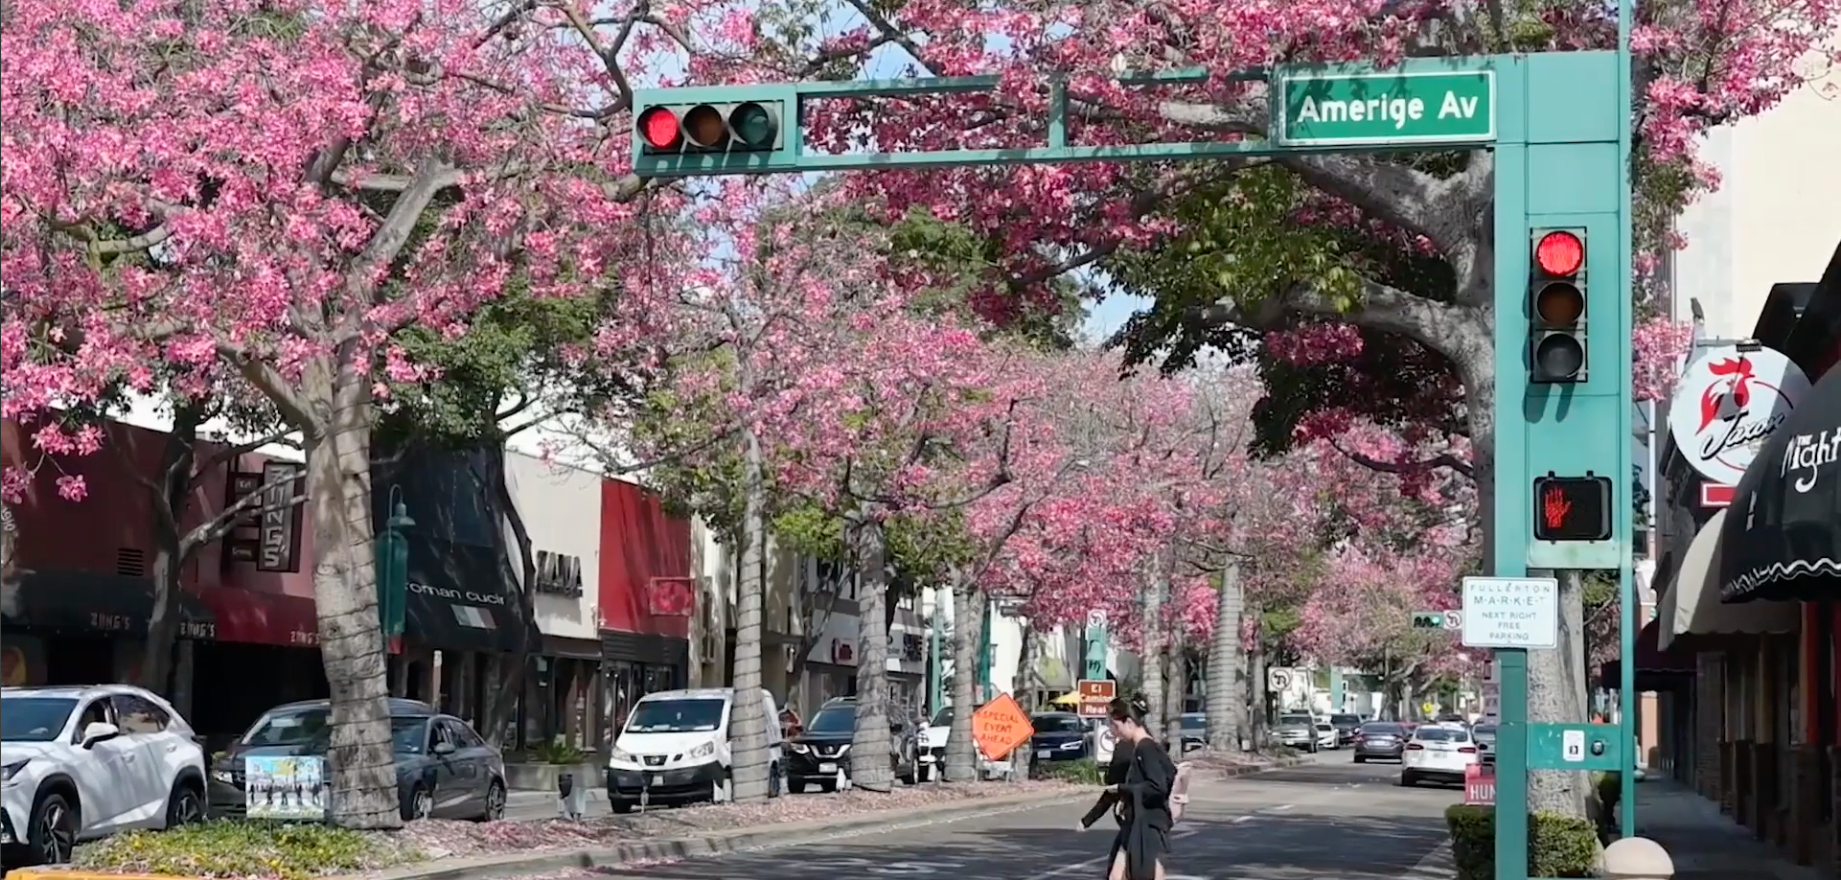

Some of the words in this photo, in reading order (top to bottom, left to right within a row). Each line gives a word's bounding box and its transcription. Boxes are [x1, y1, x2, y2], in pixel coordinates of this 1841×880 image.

[1297, 93, 1425, 130] Amerige
[1437, 90, 1479, 119] Av
[1780, 426, 1841, 494] Night
[1470, 583, 1550, 594] FULLERTON
[1482, 611, 1506, 620] NEXT
[1509, 611, 1537, 620] RIGHT
[1498, 621, 1521, 630] FREE
[1489, 632, 1529, 641] PARKING
[1090, 683, 1102, 693] El
[1085, 703, 1107, 714] Real
[983, 710, 1019, 724] SPECIAL
[983, 723, 1013, 734] EVENT
[980, 733, 1013, 745] AHEAD
